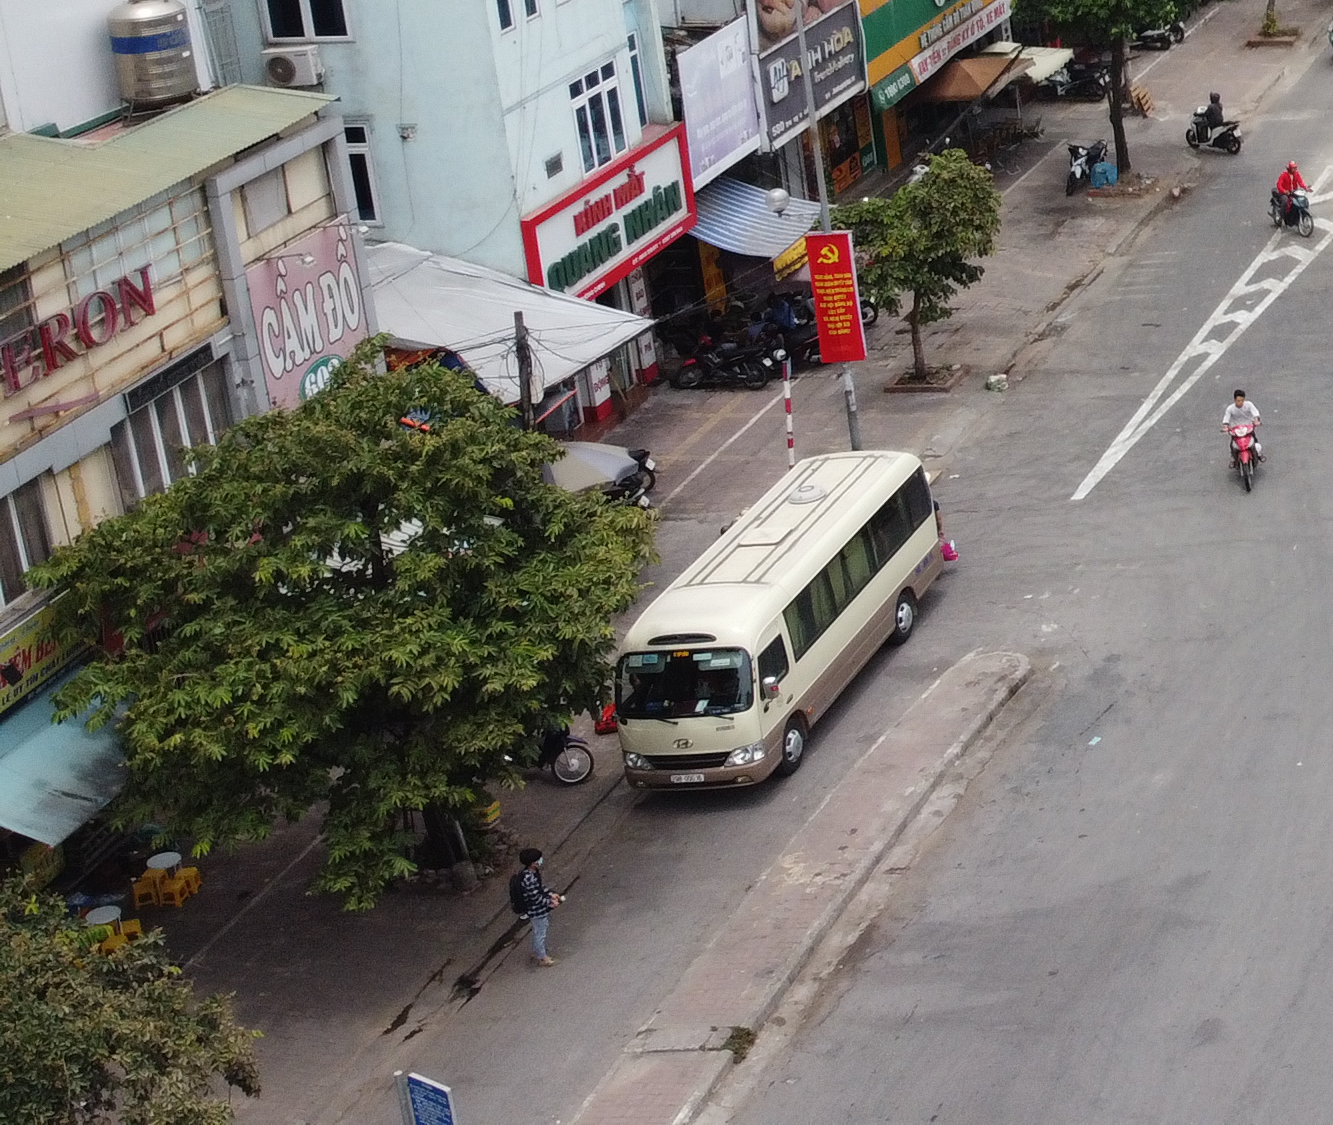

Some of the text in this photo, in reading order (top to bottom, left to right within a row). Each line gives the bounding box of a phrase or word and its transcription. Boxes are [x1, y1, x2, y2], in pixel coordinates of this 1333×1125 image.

[573, 192, 614, 237] KÍNH
[547, 222, 623, 294] QUANG
[262, 223, 361, 380] CẦM ĐỒ
